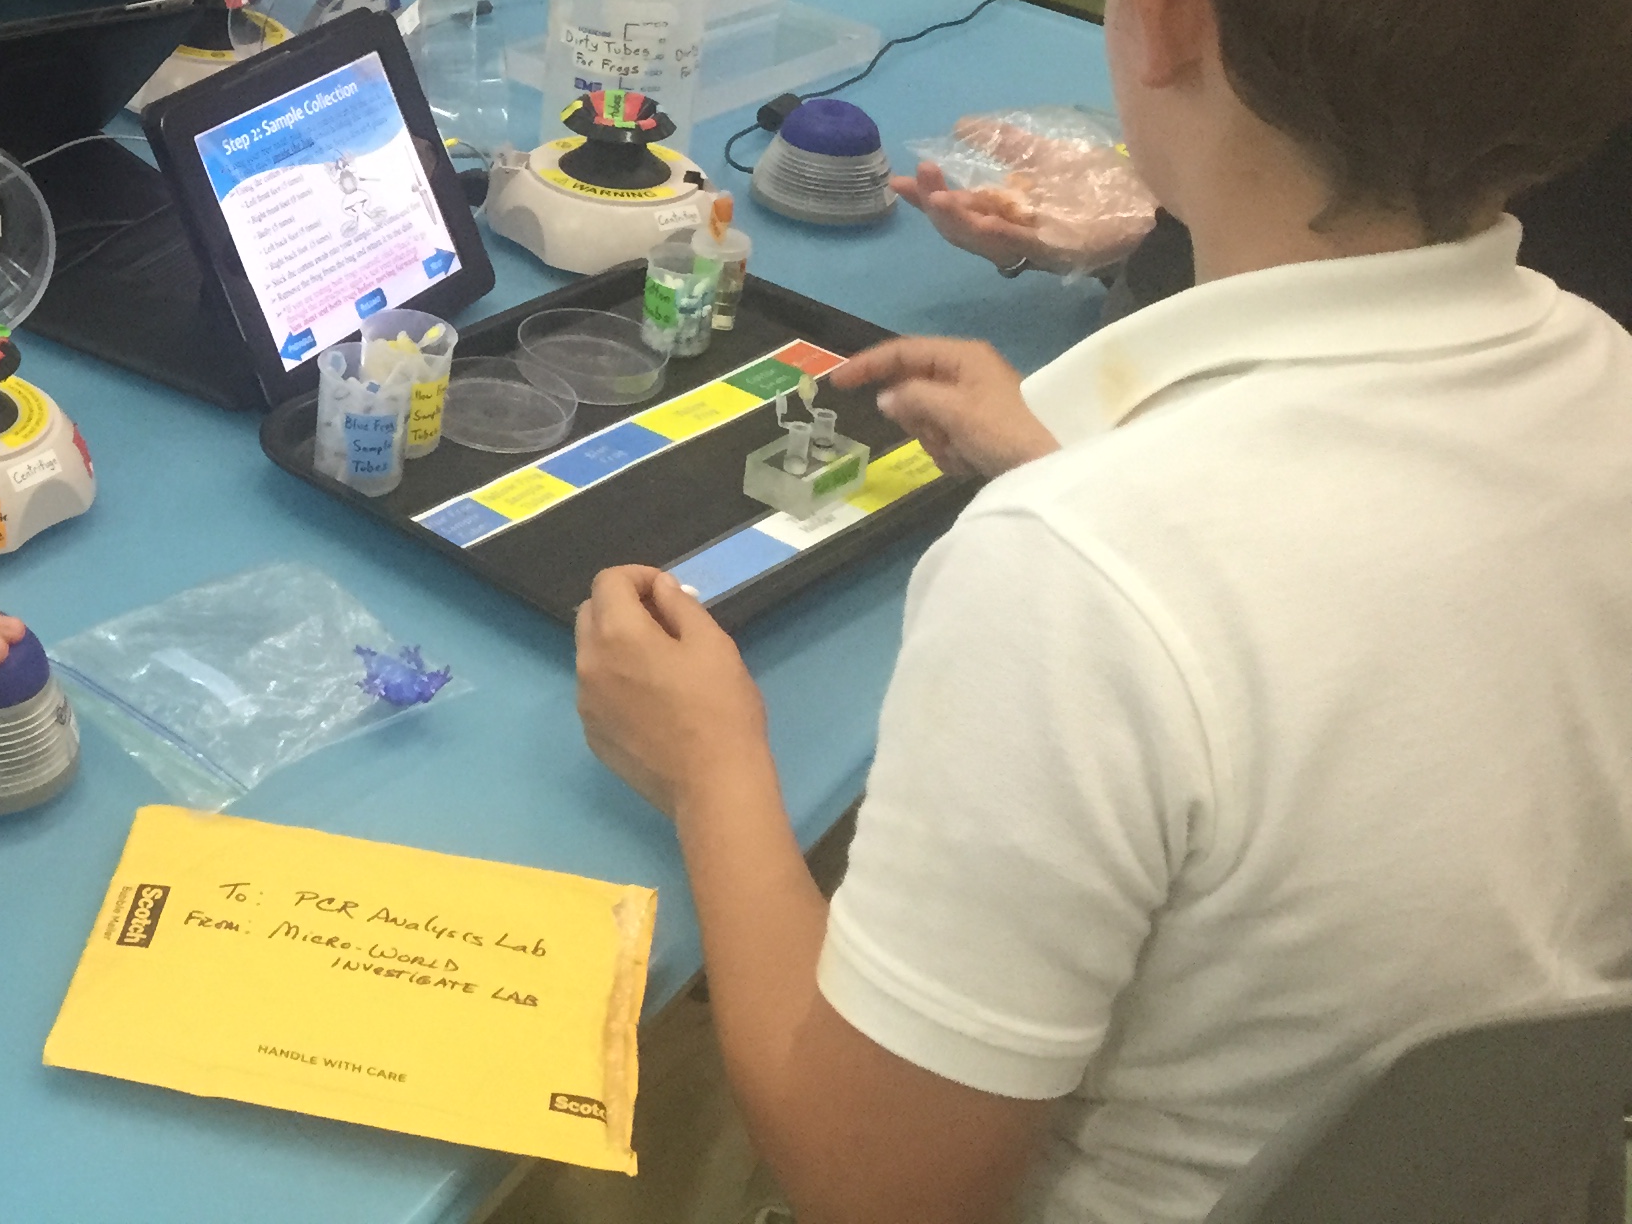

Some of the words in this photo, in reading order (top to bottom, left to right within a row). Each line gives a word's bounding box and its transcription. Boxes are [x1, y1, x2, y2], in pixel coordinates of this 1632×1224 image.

[565, 29, 598, 52] Dirty
[604, 41, 650, 56] Tubes
[576, 52, 594, 66] For
[601, 58, 640, 76] Frogs
[222, 133, 250, 155] Step
[251, 126, 263, 142] 2:
[261, 107, 305, 136] Sample
[303, 81, 359, 115] Collection
[572, 182, 658, 199] WARNING
[345, 416, 368, 431] Blue
[373, 419, 395, 435] Frog
[353, 439, 392, 455] Sample
[13, 456, 58, 485] Centrifuge
[352, 460, 388, 473] Tubes
[124, 887, 163, 944] Scotch
[219, 882, 264, 907] To:
[295, 891, 359, 919] PCR
[495, 933, 547, 958] Lab
[491, 988, 539, 1007] LAB
[257, 1044, 318, 1065] HANDLE
[323, 1057, 363, 1074] WITH
[366, 1066, 408, 1083] CARE
